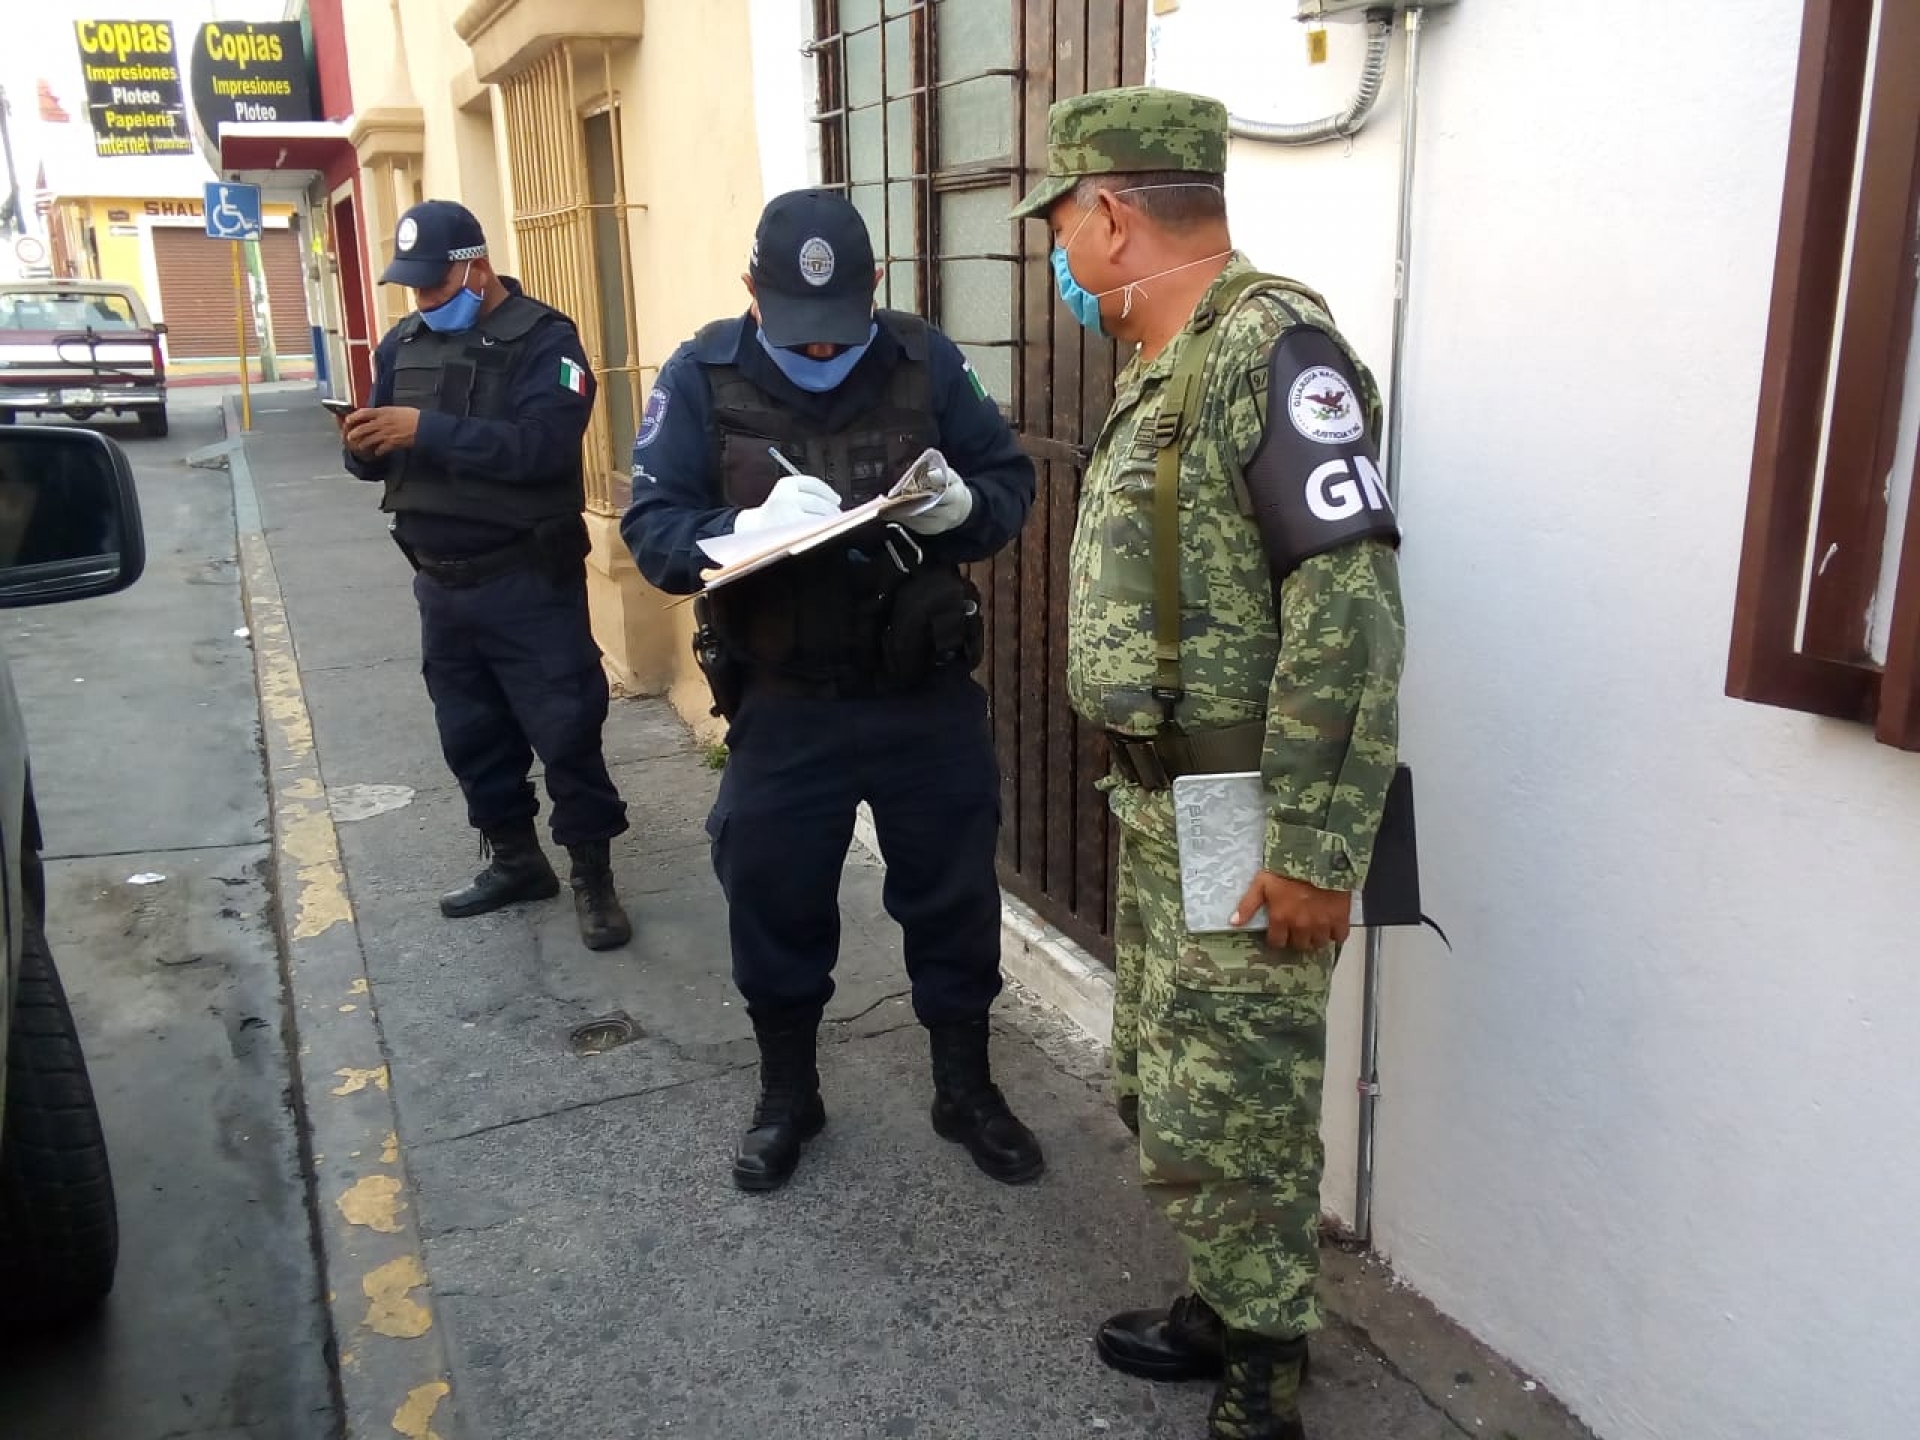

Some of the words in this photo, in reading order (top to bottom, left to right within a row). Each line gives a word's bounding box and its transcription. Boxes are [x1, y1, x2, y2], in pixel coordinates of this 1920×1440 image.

[77, 20, 172, 62] Copias
[205, 24, 283, 69] Copias
[87, 64, 177, 84] Impresiones
[113, 87, 160, 104] Ploteo
[213, 76, 291, 98] Impresiones
[235, 102, 276, 120] Ploteo
[144, 201, 205, 217] SHAL
